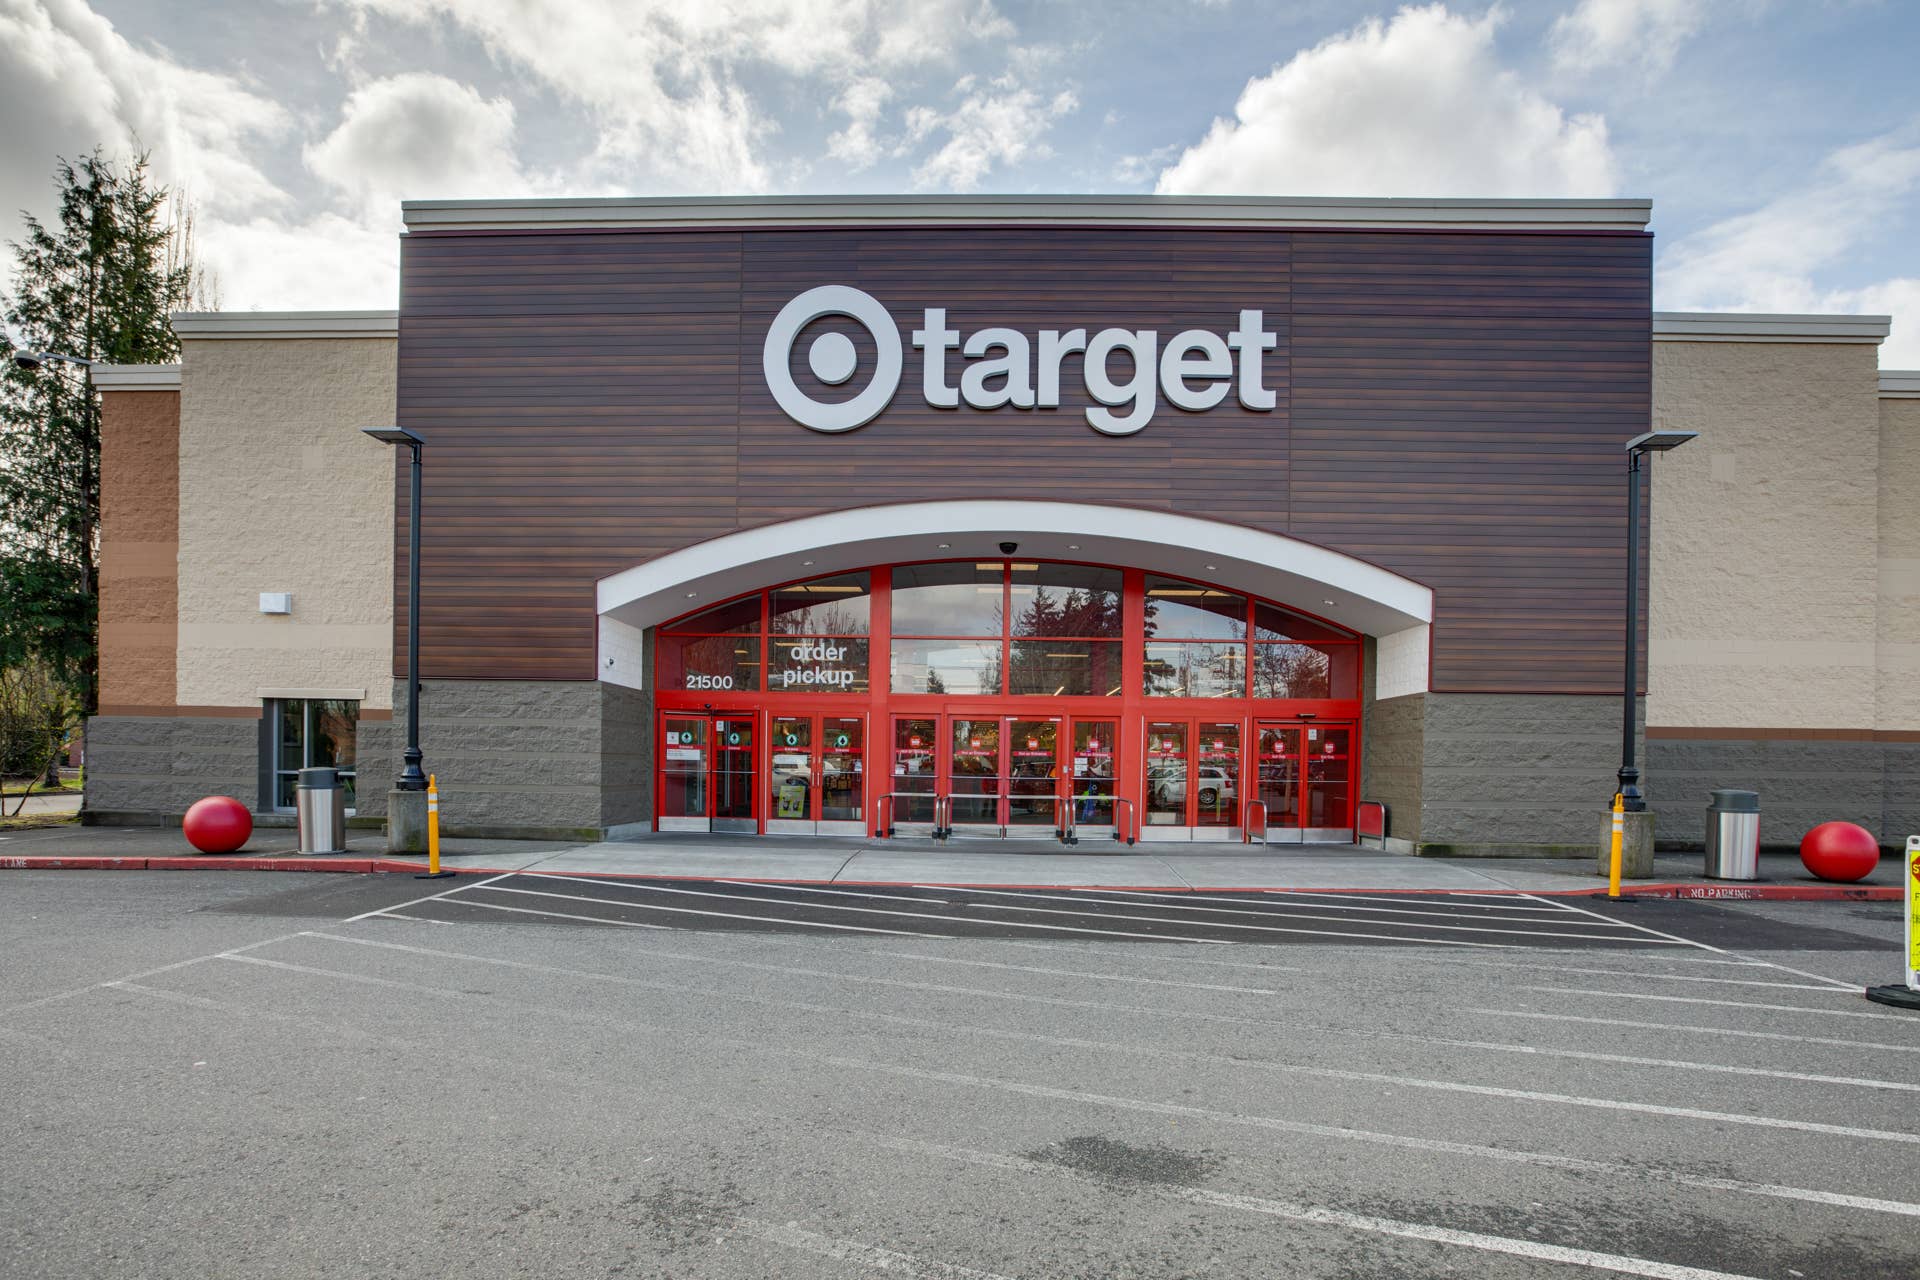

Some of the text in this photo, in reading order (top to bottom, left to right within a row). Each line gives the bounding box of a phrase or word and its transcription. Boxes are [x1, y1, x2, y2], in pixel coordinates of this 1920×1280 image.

[912, 307, 1277, 436] target
[790, 642, 848, 661] order
[686, 674, 733, 689] 21500
[783, 665, 854, 688] pickup
[4, 856, 27, 868] LANE
[1690, 888, 1704, 898] NO
